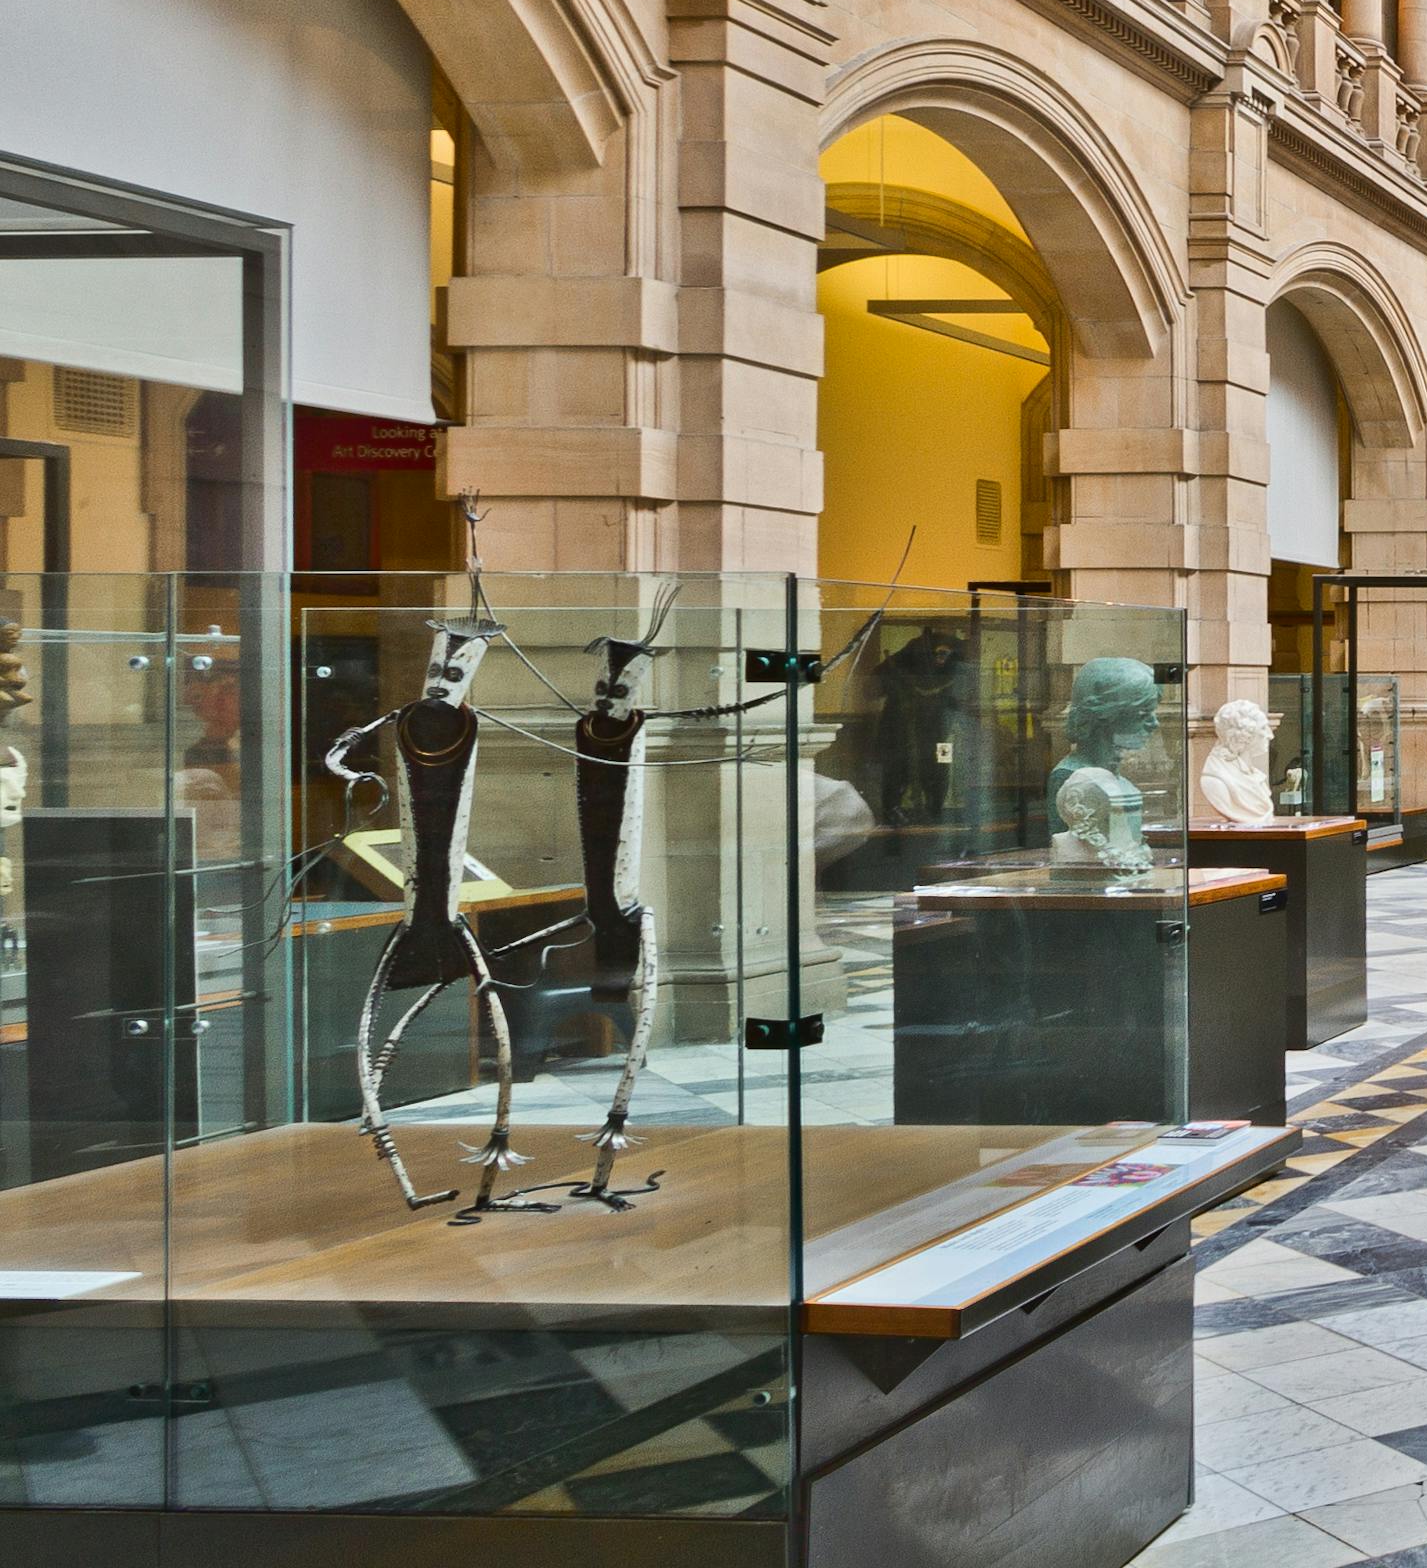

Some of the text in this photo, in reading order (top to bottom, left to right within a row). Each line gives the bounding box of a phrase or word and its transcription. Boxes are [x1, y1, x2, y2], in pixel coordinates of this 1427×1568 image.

[372, 426, 425, 441] Looking
[333, 445, 353, 458] Art
[358, 445, 420, 460] Discovery
